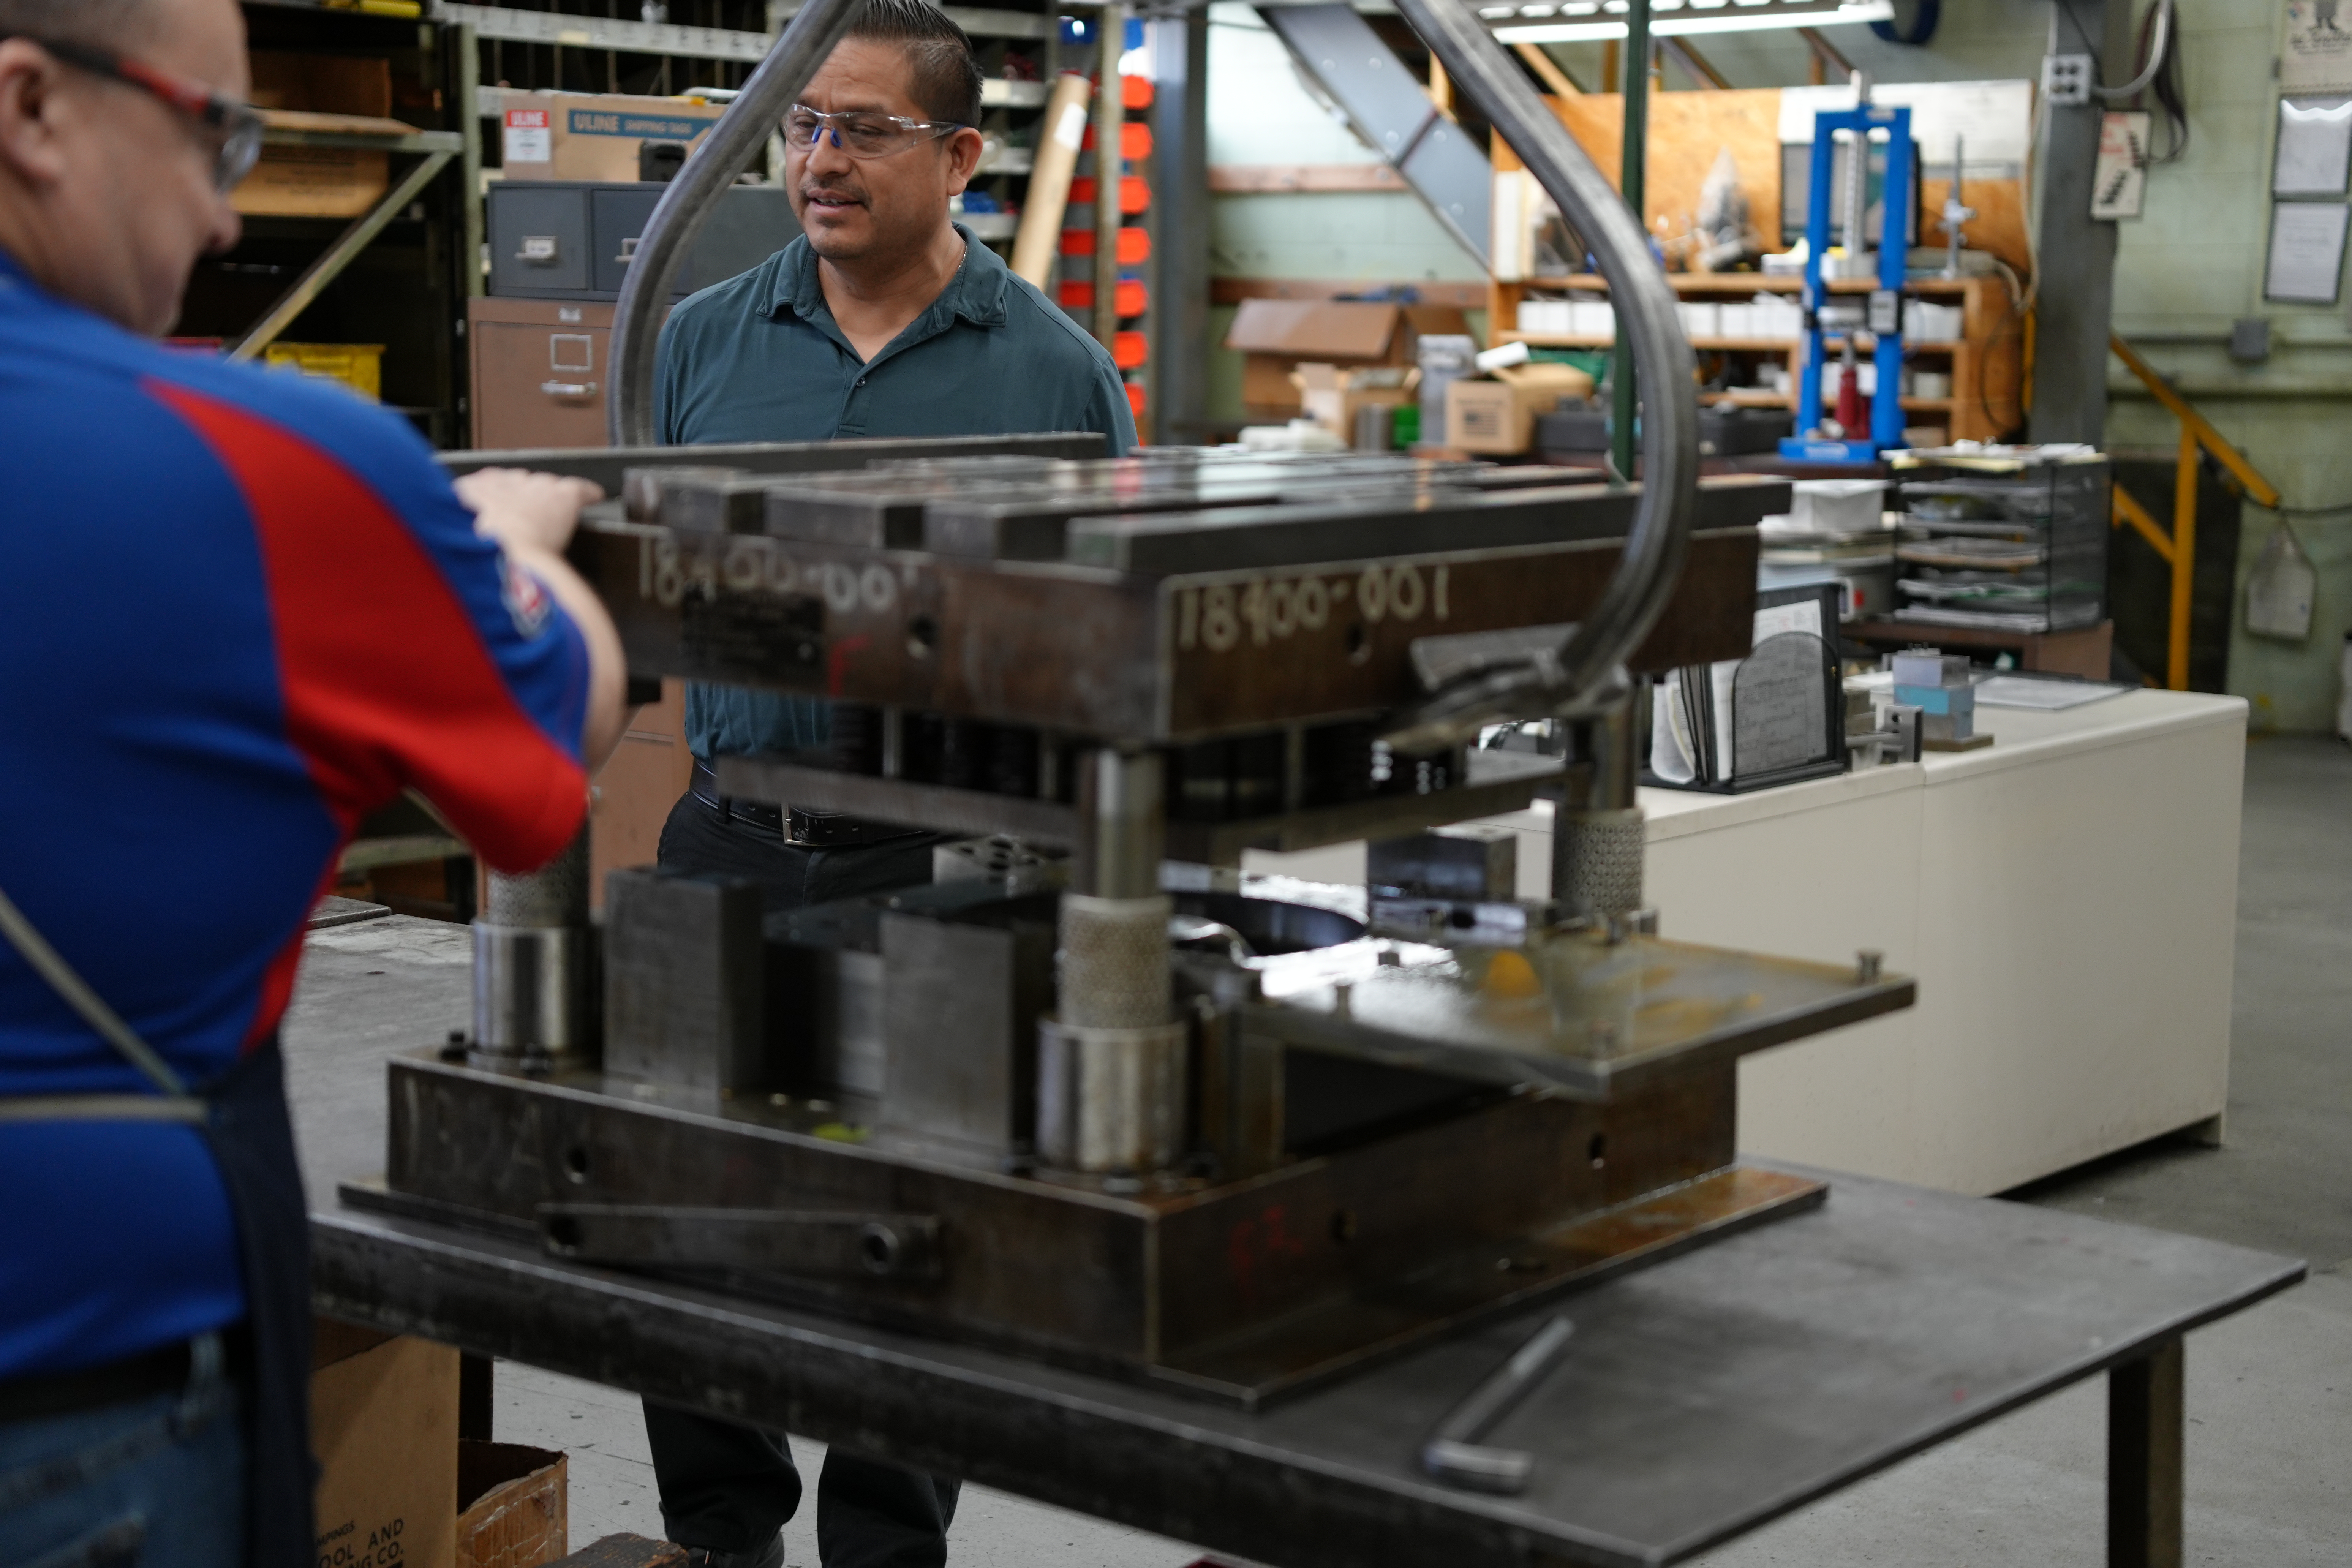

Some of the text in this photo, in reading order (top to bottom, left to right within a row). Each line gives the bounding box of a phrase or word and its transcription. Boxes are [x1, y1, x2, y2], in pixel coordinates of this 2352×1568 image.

[511, 111, 544, 125] ULINE
[574, 114, 620, 133] ULINE
[316, 1520, 355, 1547] MPINGS
[318, 1518, 403, 1568] OOL AND
[377, 1541, 403, 1565] CO.
